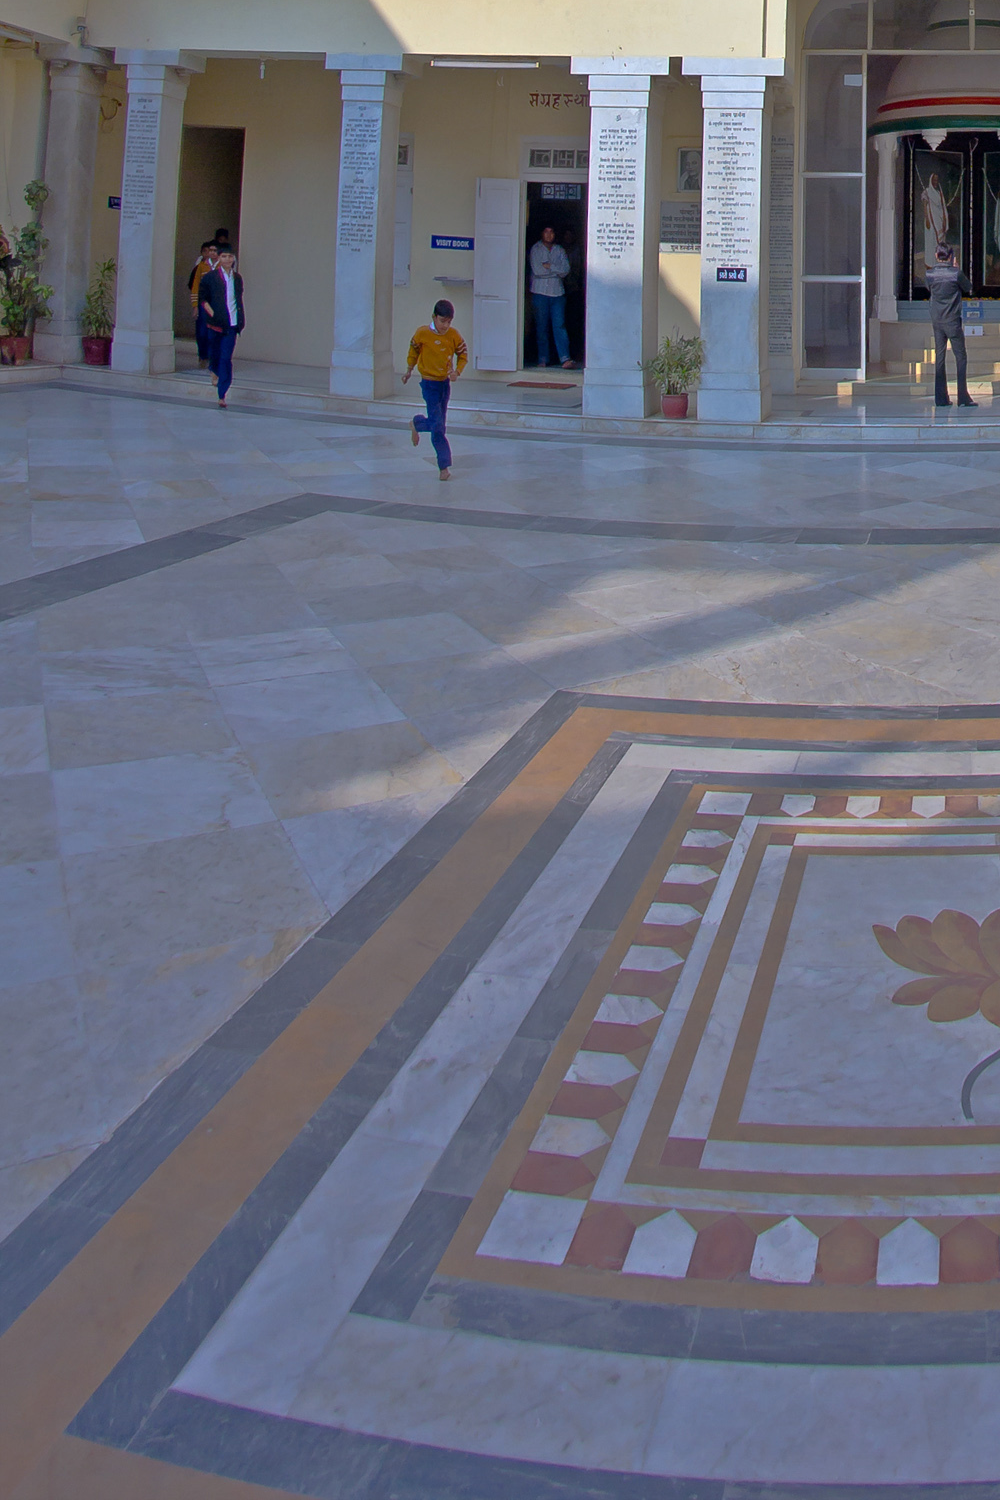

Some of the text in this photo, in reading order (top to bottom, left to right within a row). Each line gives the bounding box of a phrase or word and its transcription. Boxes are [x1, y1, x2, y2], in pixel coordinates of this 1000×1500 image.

[528, 89, 589, 110] संग्रहस्था
[436, 238, 470, 248] VISIT BOOK
